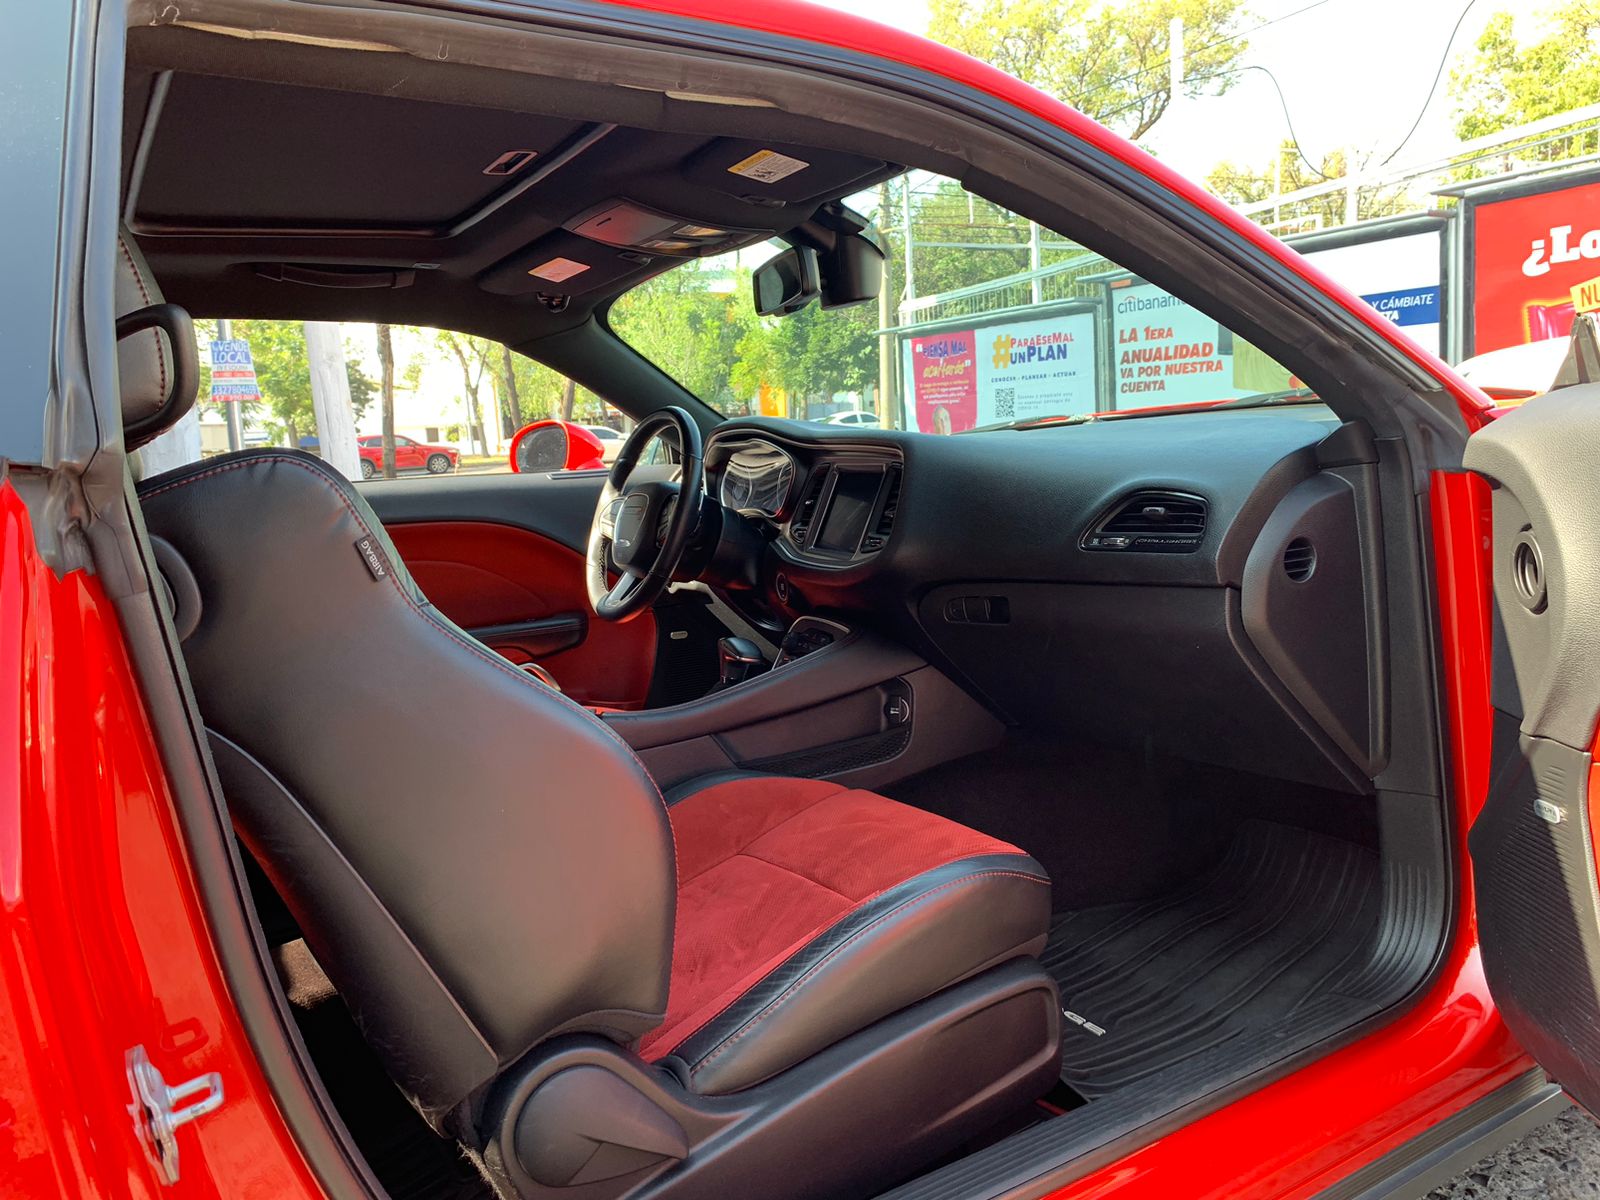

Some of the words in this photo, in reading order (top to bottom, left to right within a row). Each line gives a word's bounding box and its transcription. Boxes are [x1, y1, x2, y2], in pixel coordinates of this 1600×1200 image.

[1380, 293, 1434, 310] CÁMBIATE
[1119, 328, 1138, 344] LA
[1144, 326, 1174, 341] 1ERA
[214, 352, 249, 363] LOCAL
[1120, 342, 1214, 365] ANUALIDAD
[1120, 367, 1134, 379] VA
[1138, 365, 1161, 378] POR
[1165, 360, 1223, 375] NUESTRA
[1120, 380, 1166, 394] CUENTA
[361, 540, 385, 576] AIRBAG
